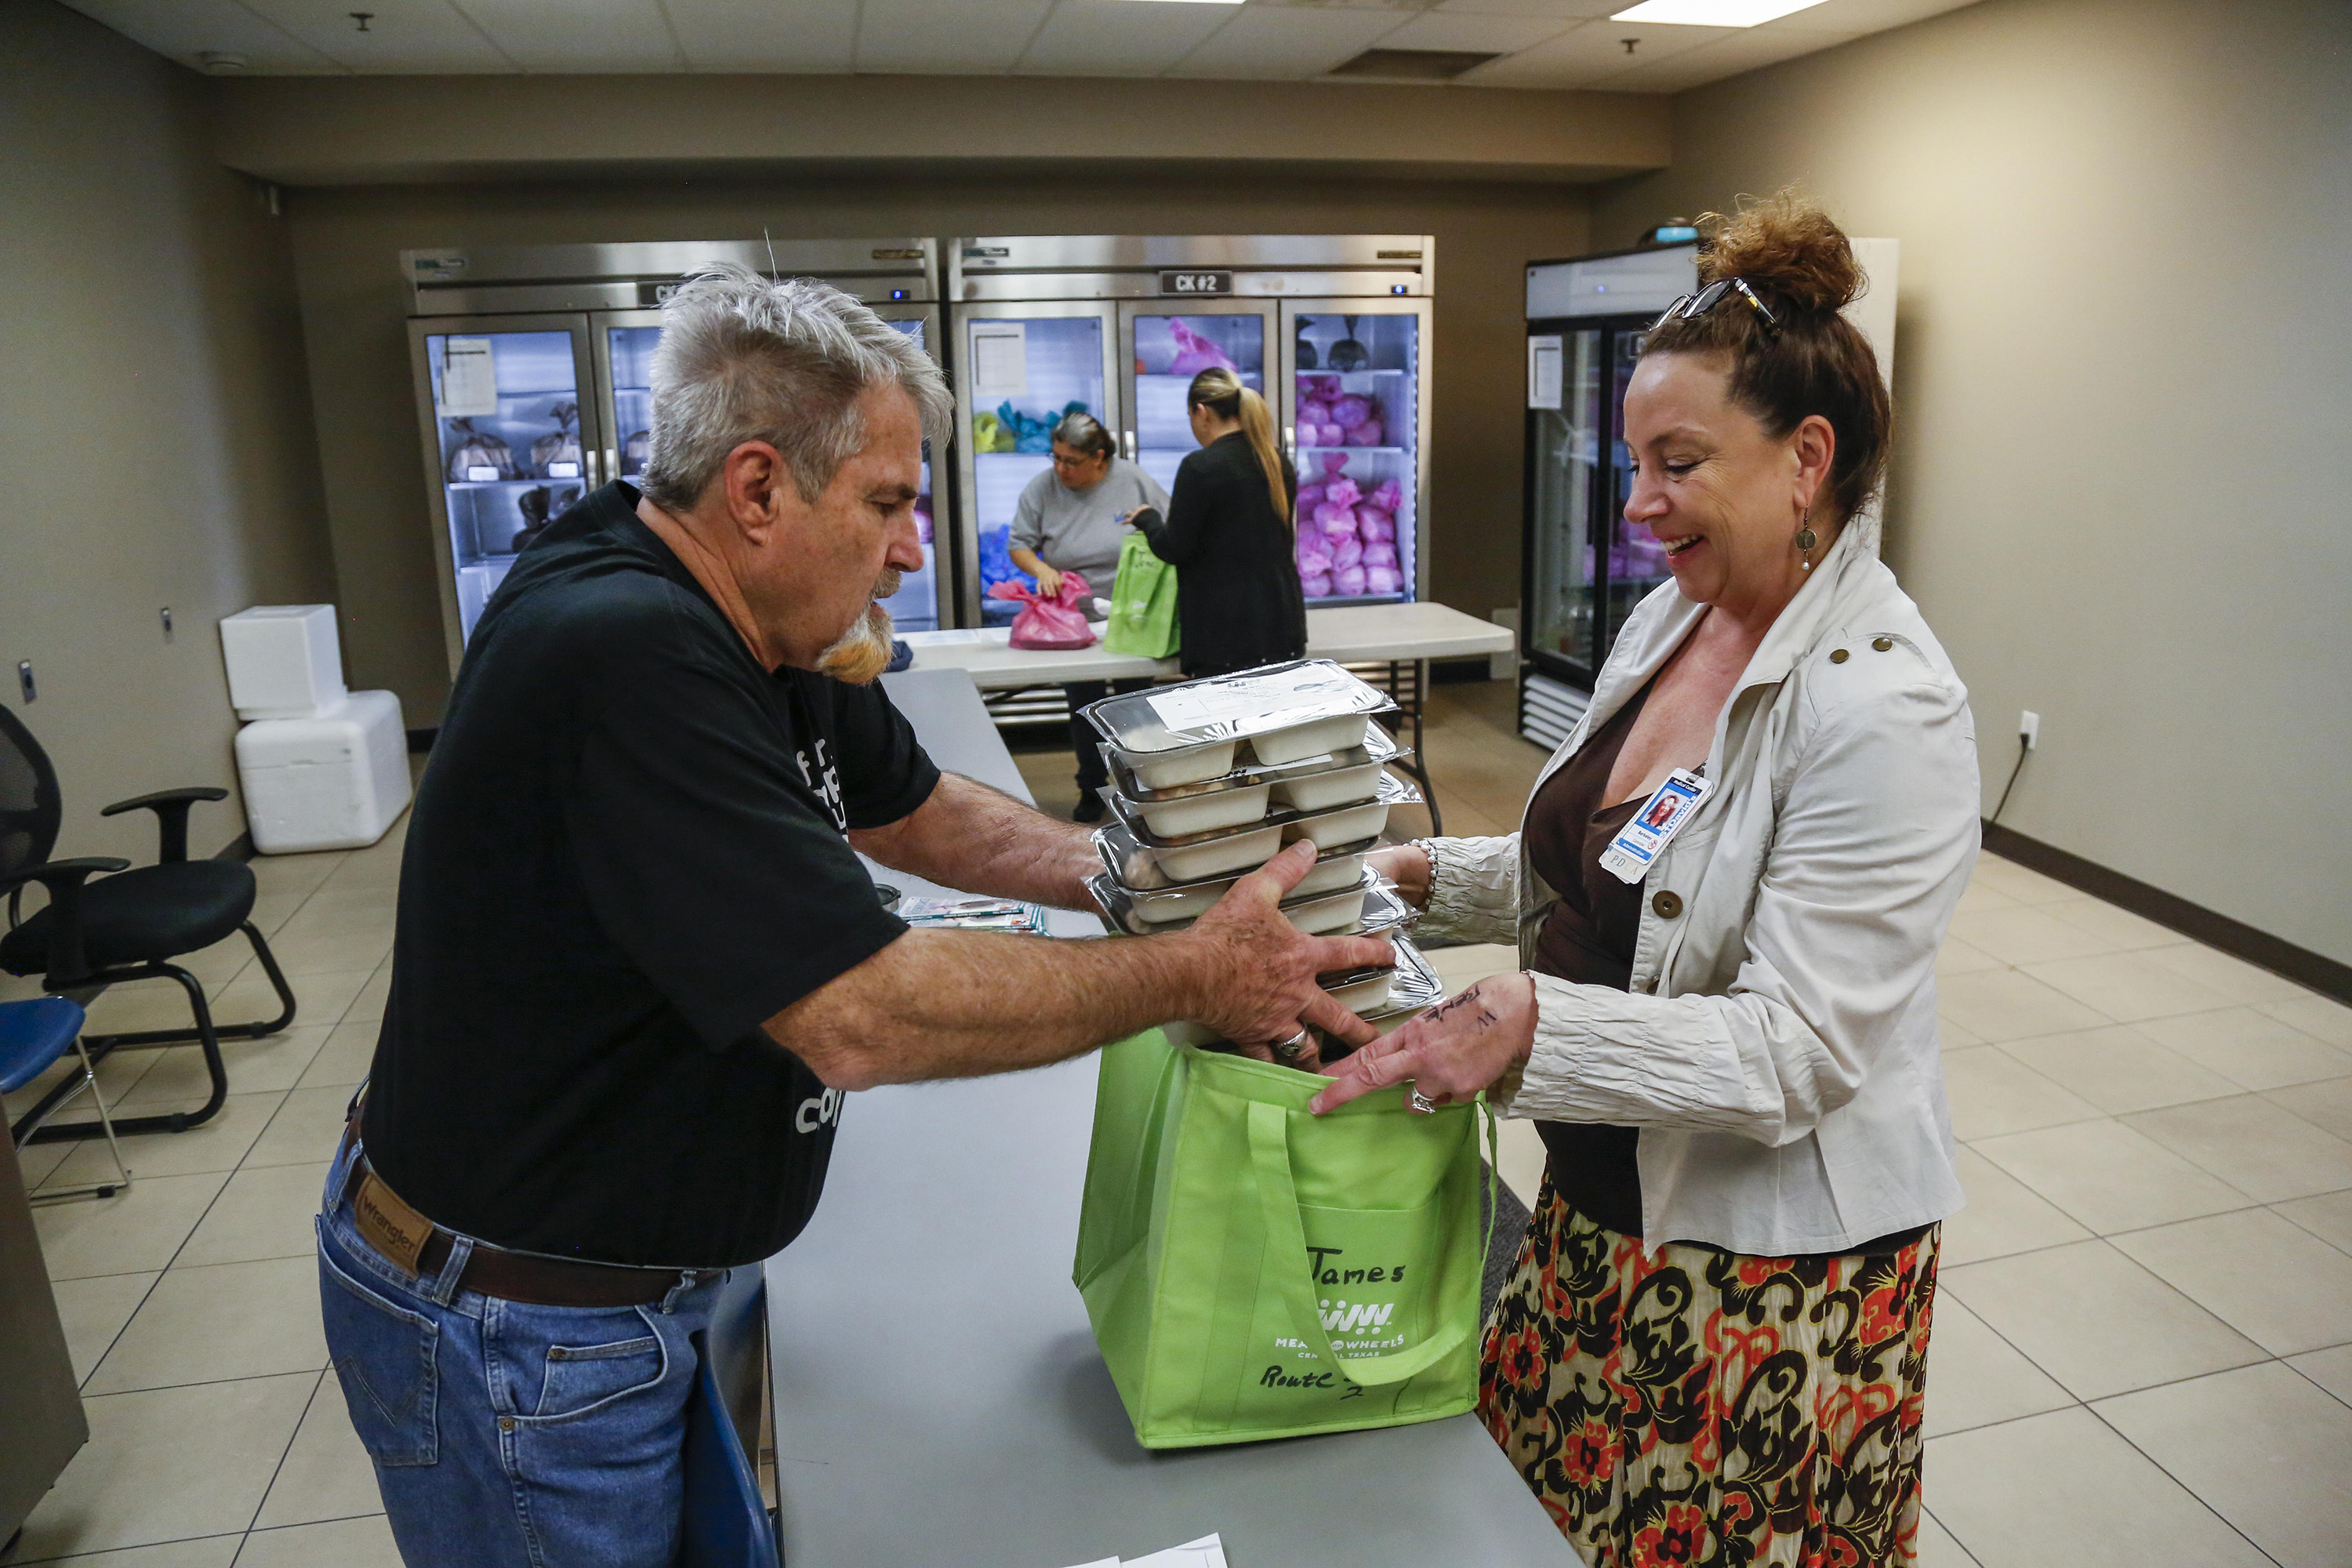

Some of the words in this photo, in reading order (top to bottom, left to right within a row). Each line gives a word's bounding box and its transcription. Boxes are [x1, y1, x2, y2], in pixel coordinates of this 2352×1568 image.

[1176, 274, 1196, 292] CK
[1197, 274, 1217, 292] #2
[364, 1196, 416, 1252] Wrangler
[1346, 1334, 1404, 1349] WHEELS
[1259, 1364, 1336, 1388] Route
